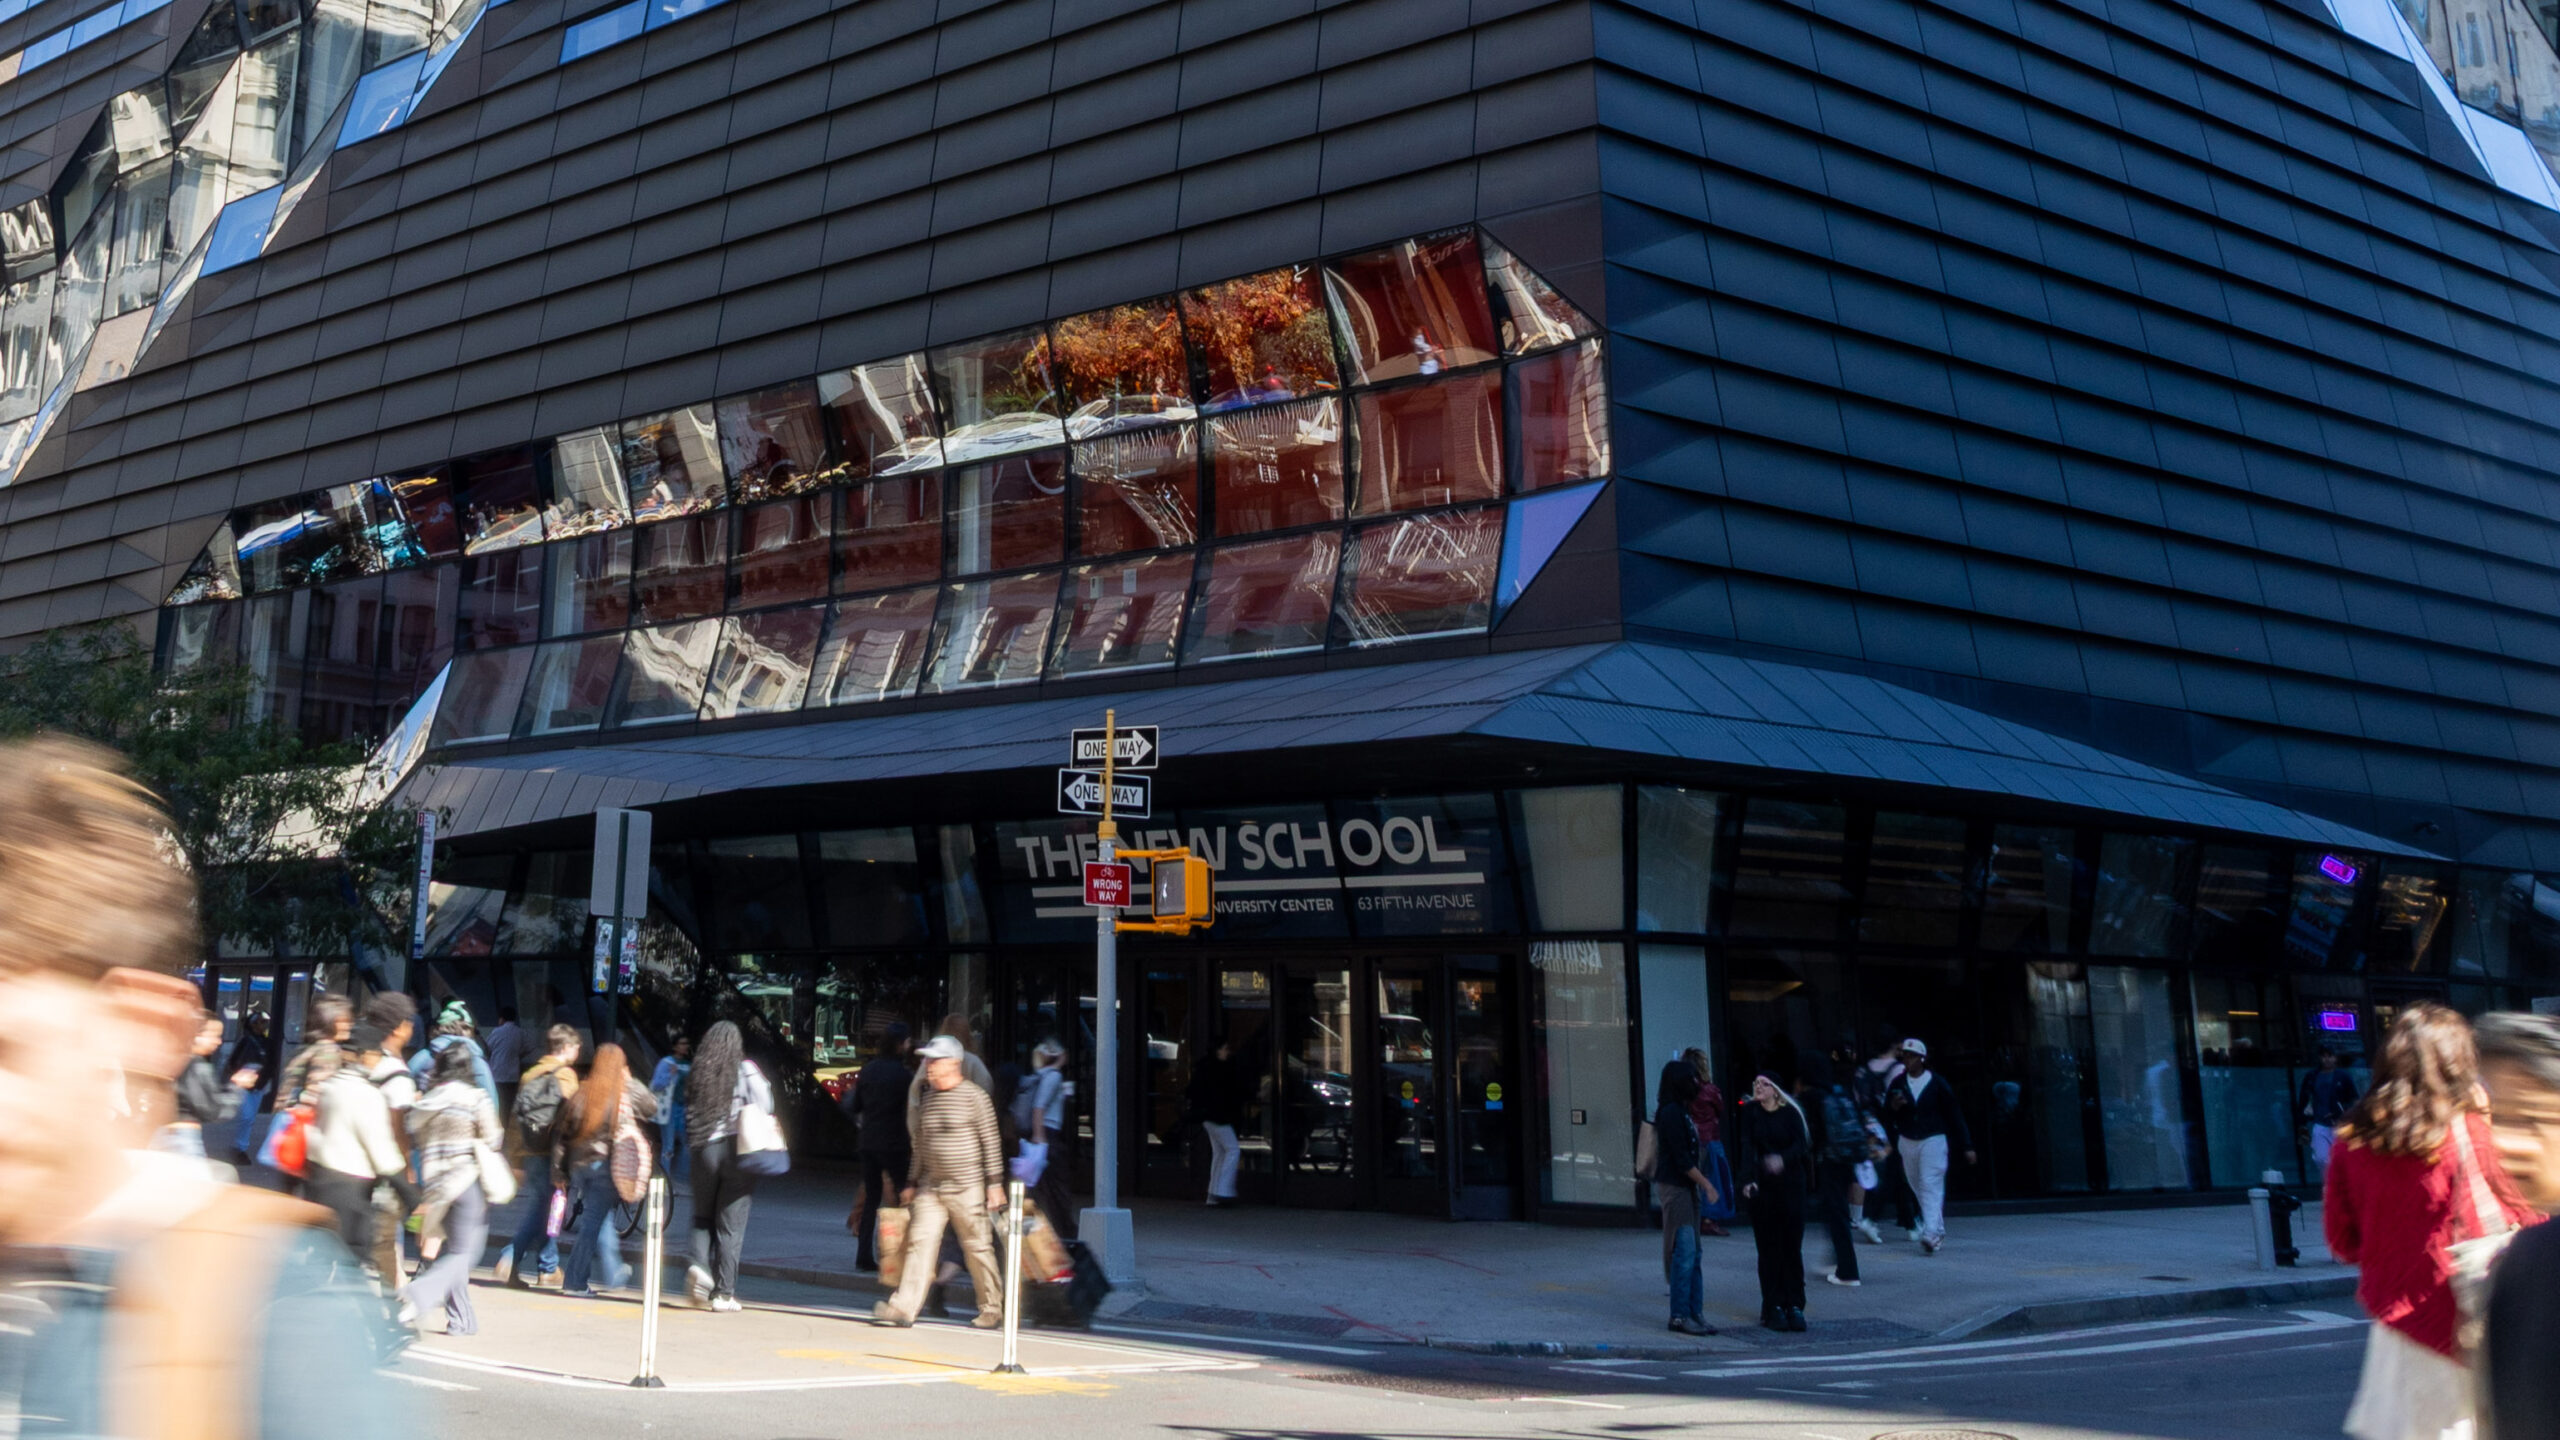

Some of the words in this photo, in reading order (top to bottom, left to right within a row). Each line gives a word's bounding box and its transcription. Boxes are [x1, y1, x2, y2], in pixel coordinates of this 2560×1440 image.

[1084, 742, 1107, 757] ONE
[1119, 740, 1144, 755] WAY
[1074, 784, 1099, 800] ONE
[1112, 787, 1138, 803] WAY
[1015, 832, 1100, 878] THE
[1115, 825, 1227, 875] NEW
[1237, 815, 1467, 871] SCHOOL
[1093, 878, 1123, 890] WRONG
[1098, 890, 1117, 902] WAY
[1358, 898, 1373, 911] 63
[1375, 895, 1413, 910] FIFTH
[1415, 893, 1475, 909] AVENUE
[1214, 899, 1278, 914] NIVERSITY
[1280, 898, 1334, 912] CENTER
